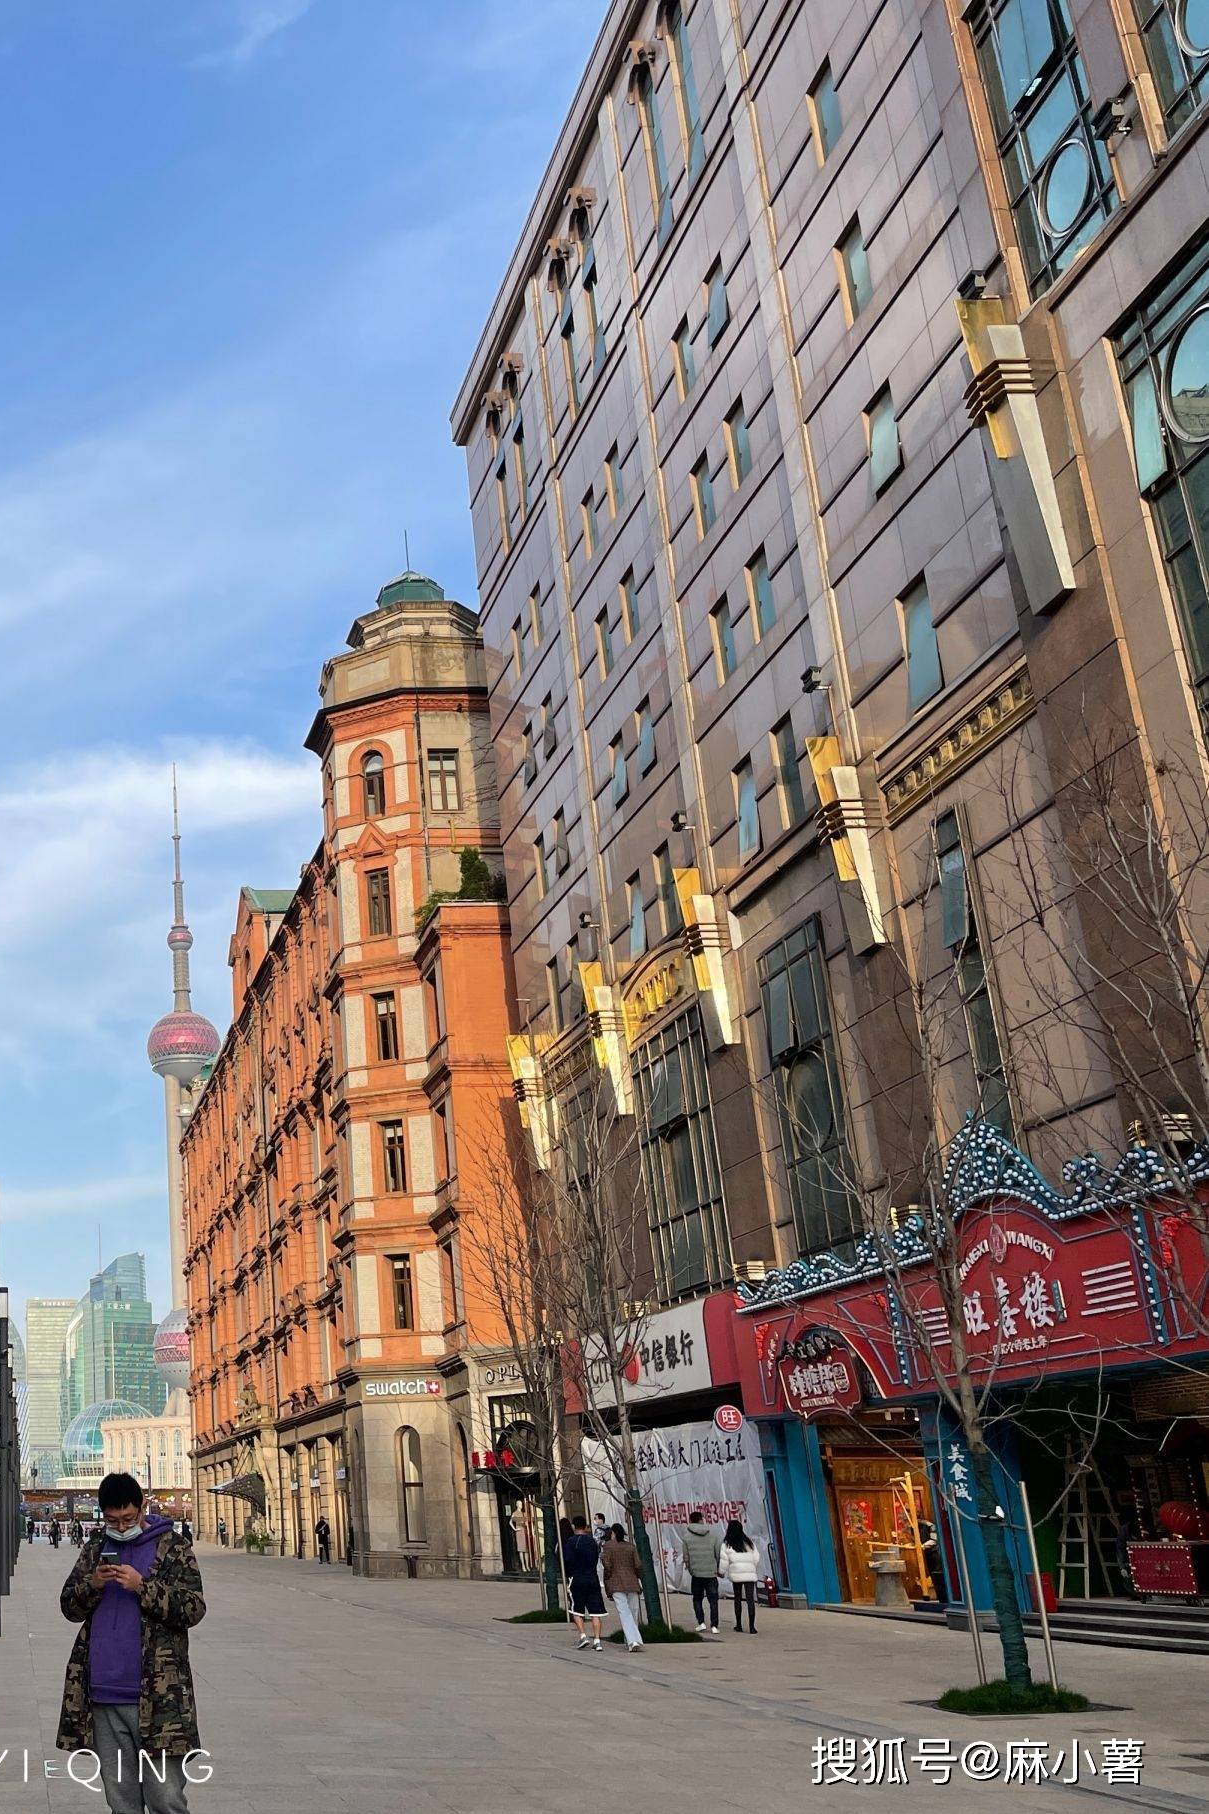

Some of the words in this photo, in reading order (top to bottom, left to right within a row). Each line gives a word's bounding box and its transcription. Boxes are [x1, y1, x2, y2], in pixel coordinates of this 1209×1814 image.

[1006, 1231, 1054, 1261] WANGXI
[958, 1239, 990, 1282] ANGXI
[366, 1379, 427, 1396] swatch
[721, 1410, 738, 1424] 旺
